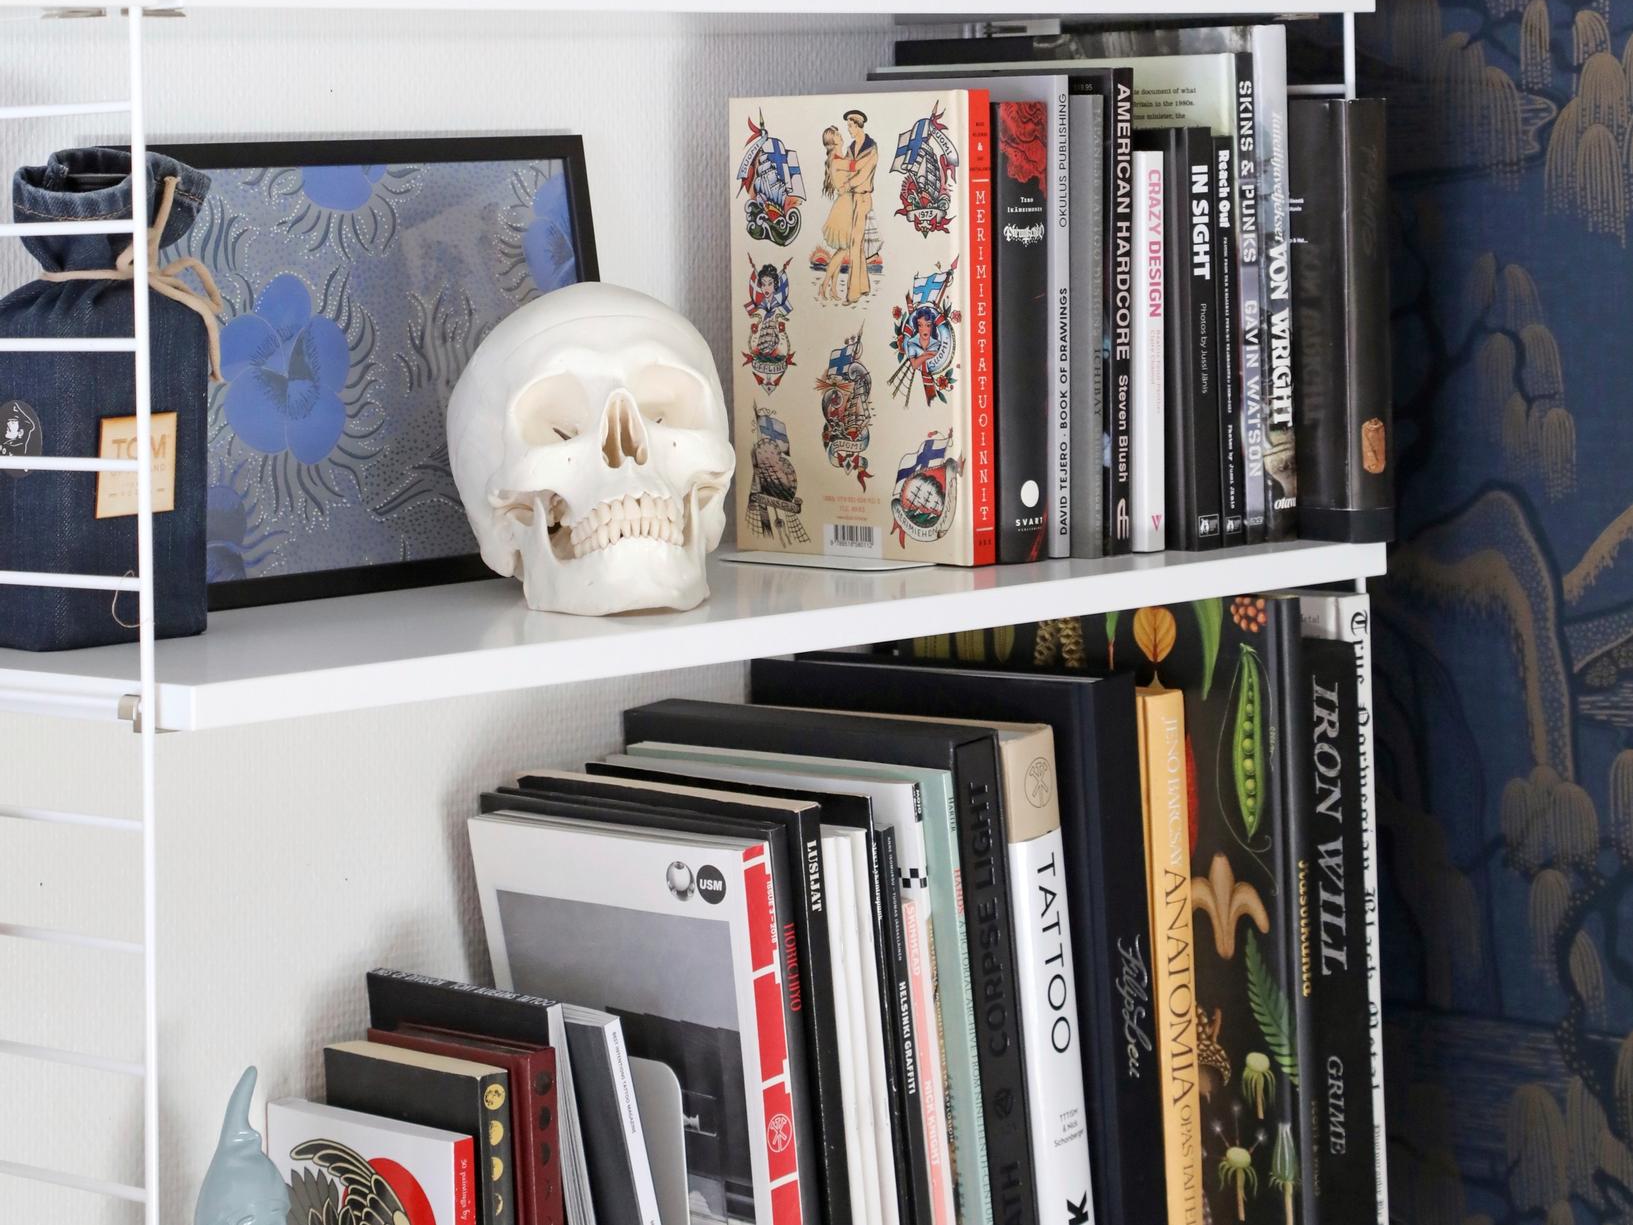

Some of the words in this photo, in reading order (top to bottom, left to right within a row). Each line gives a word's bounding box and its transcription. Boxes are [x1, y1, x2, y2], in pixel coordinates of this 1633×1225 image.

[931, 126, 953, 156] SUOMI
[1059, 93, 1067, 170] PUBLISHING
[1239, 80, 1254, 151] SKINS
[741, 143, 761, 175] SUOMI
[1117, 84, 1130, 213] AMERICAN
[1218, 149, 1230, 197] Reach
[1241, 160, 1254, 176] &
[1059, 175, 1067, 228] OKULUS
[1148, 169, 1161, 235] CRAZY
[1192, 165, 1209, 193] IN
[918, 209, 934, 218] 1973
[1193, 199, 1210, 280] SIGHT
[1219, 200, 1231, 228] Out
[1241, 185, 1257, 263] PUNKS
[1116, 222, 1130, 360] HARDCORE
[1149, 240, 1162, 318] DESIGN
[1269, 240, 1288, 300] VON
[1059, 287, 1068, 362] DRAWINGS
[1200, 336, 1207, 348] by
[1244, 300, 1260, 368] GAVIN
[975, 190, 989, 521] MERIMIESTATUOINNIT
[1059, 366, 1068, 384] OF
[1270, 307, 1293, 426] WRIGHT
[1059, 390, 1068, 429] BOOK
[1118, 375, 1128, 430] Steven
[1247, 375, 1264, 477] WATSON
[832, 440, 862, 452] SUOMI
[1059, 444, 1068, 489] TEJERO
[1118, 436, 1128, 482] Blush
[1015, 516, 1043, 527] SVART
[1059, 495, 1068, 536] DAVID
[1312, 675, 1343, 823] IRON
[948, 797, 957, 832] HARTER
[968, 781, 997, 890] LIGHT
[1166, 778, 1182, 868] BARCSAY
[699, 878, 723, 892] USM
[807, 840, 822, 912] LUSIJAT
[1317, 836, 1347, 976] WILL
[783, 922, 802, 1012] HORICHIYO
[907, 906, 920, 976] SKINHEAD
[960, 932, 972, 993] PICTORIAL
[1037, 852, 1071, 1054] TATTOO
[977, 898, 1010, 1058] CORPSE
[1115, 934, 1149, 1012] Filip
[1164, 869, 1195, 1106] ANATOMIA
[899, 981, 911, 1038] HELSINKI
[964, 998, 979, 1054] ARCHIVE
[904, 1041, 916, 1095] GRAFFITI
[971, 1056, 982, 1088] FROM
[1122, 1009, 1152, 1078] Leu
[925, 1080, 935, 1114] NICK
[1326, 1055, 1346, 1155] GRIME
[927, 1116, 939, 1165] KNIGHT
[1179, 1104, 1193, 1157] OPAS
[461, 1209, 470, 1220] by
